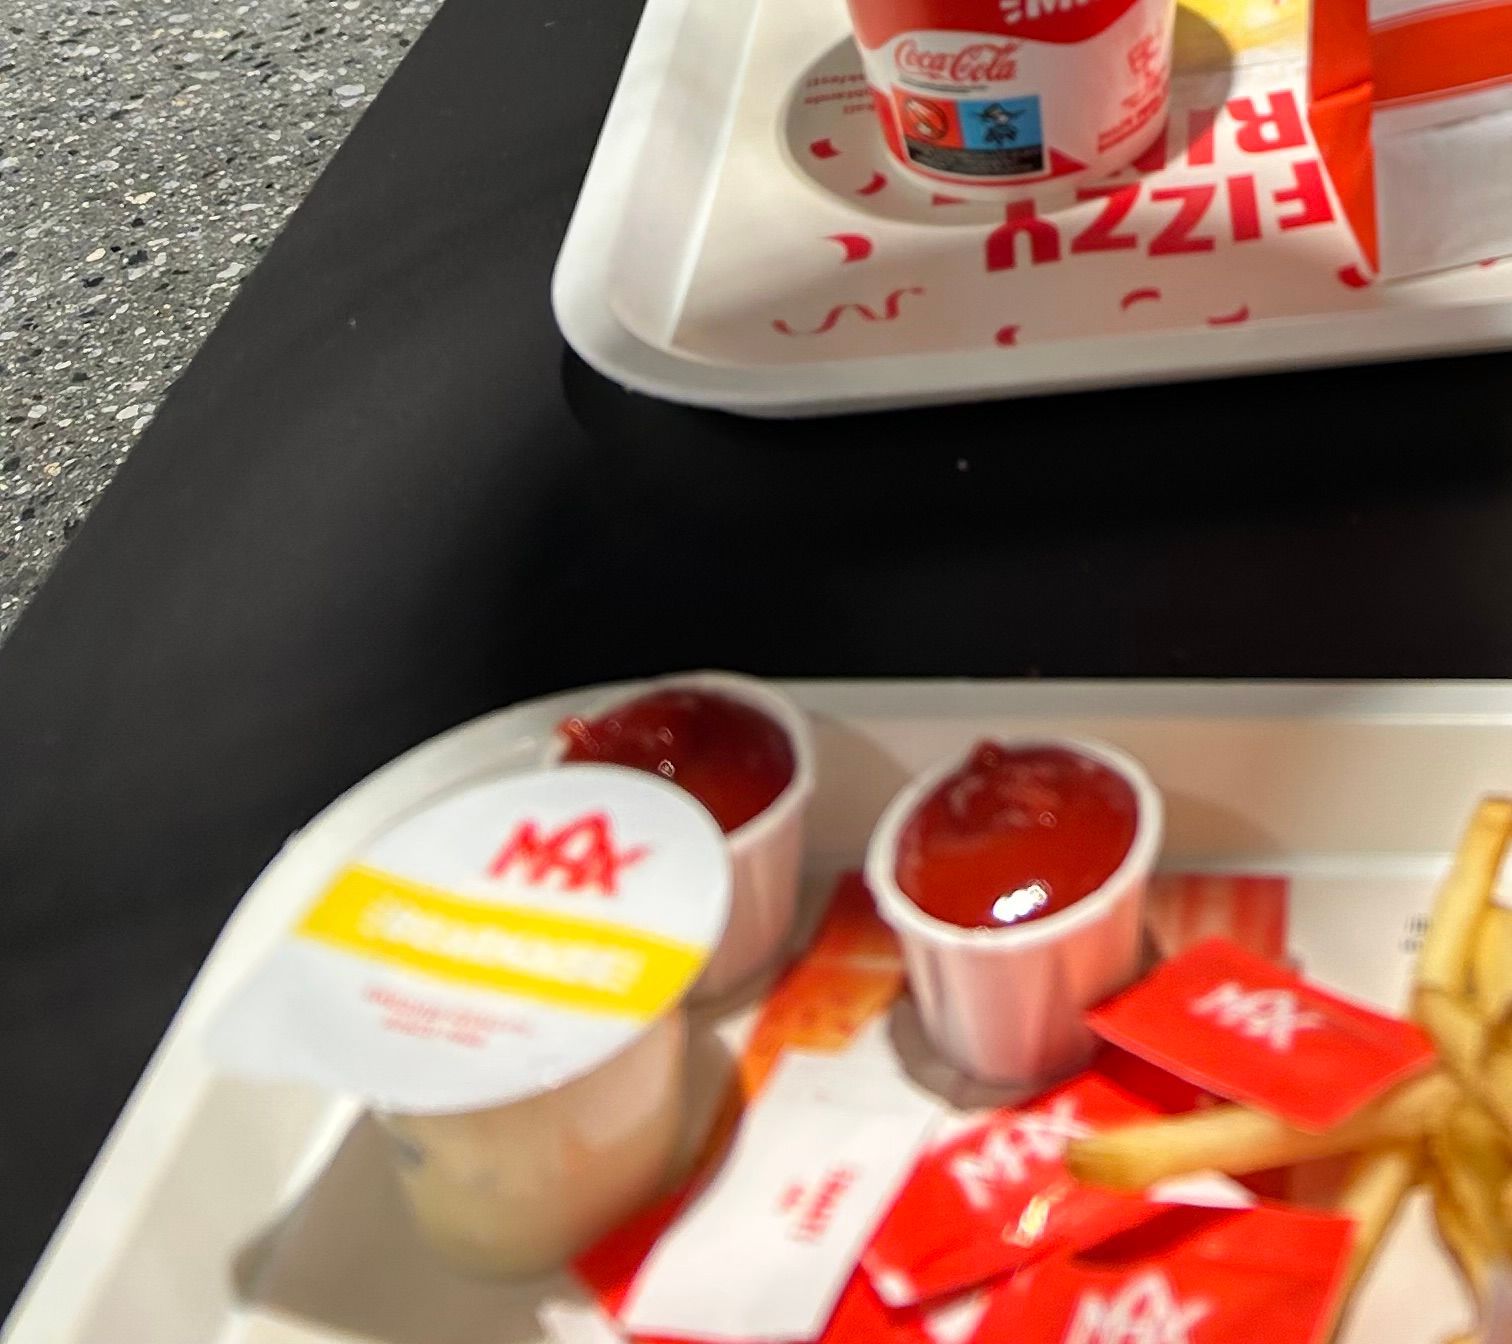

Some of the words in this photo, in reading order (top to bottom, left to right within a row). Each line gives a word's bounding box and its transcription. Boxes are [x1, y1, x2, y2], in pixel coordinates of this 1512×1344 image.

[984, 158, 1337, 273] FIZZY
[487, 810, 654, 897] MAX
[949, 1095, 1093, 1210] MAX
